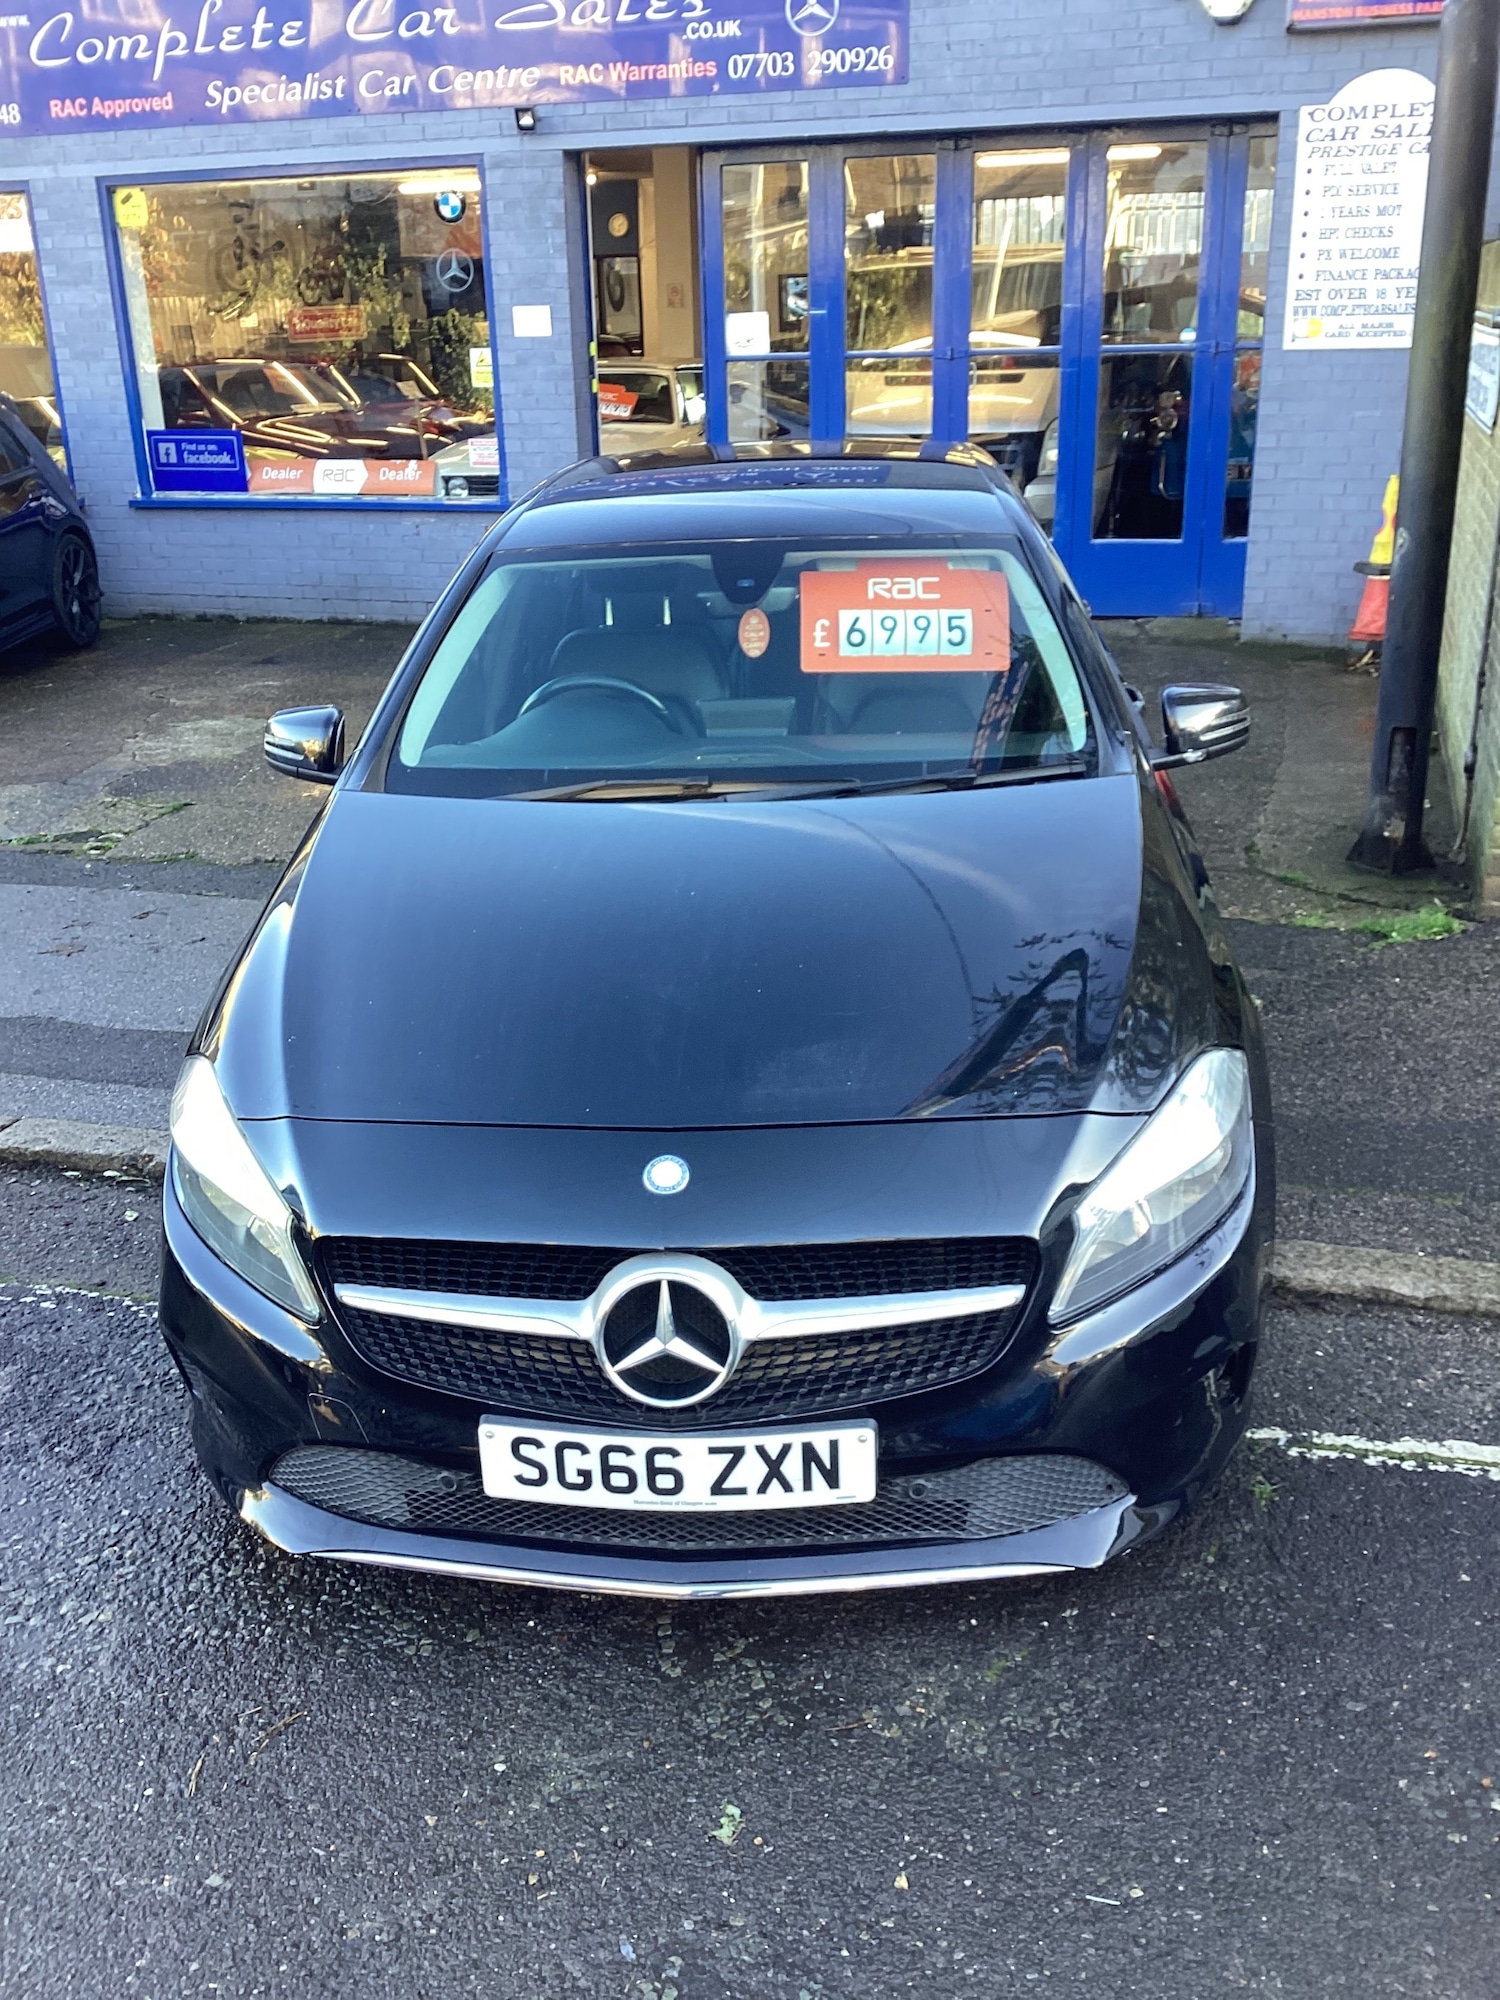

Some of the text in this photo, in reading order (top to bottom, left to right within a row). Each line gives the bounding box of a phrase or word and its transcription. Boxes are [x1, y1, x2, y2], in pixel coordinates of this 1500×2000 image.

[1355, 3, 1414, 18] BUSINESS
[29, 0, 306, 82] Complete
[345, 0, 462, 41] Car
[682, 20, 743, 40] .CO.UK
[50, 97, 87, 118] RAC
[91, 92, 173, 118] Approved
[205, 73, 345, 113] Specialist
[358, 69, 415, 98] Car
[427, 64, 541, 93] Centre
[559, 64, 603, 85] RAC
[609, 58, 717, 83] Warranties
[728, 51, 795, 79] 07703
[807, 45, 894, 76] 290926
[1305, 125, 1360, 143] CAR
[1307, 143, 1402, 159] PRESTIGE
[1347, 183, 1400, 197] SERVICE
[1331, 205, 1371, 219] YEARS
[1376, 204, 1403, 217] MOT
[1345, 226, 1394, 239] CHECKS
[1338, 247, 1401, 260] WELCOME
[1314, 268, 1369, 282] FINANCE
[1294, 289, 1322, 301] EST
[1328, 287, 1367, 300] OVER
[262, 467, 303, 481] Dealer
[510, 1435, 841, 1497] SG66 ZXN
